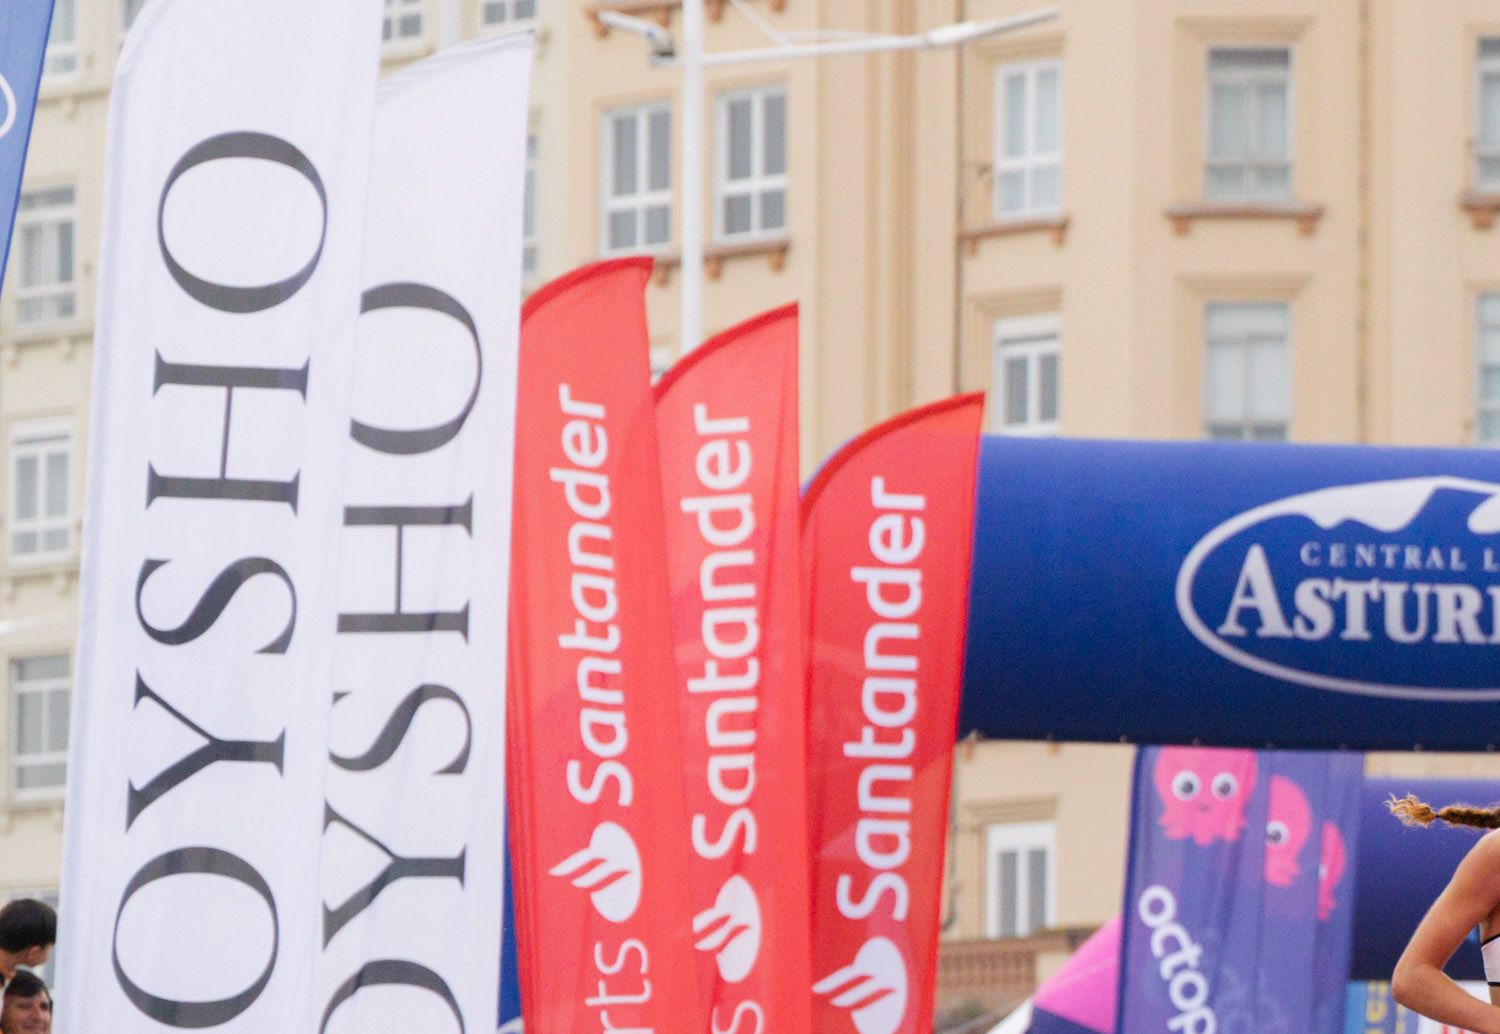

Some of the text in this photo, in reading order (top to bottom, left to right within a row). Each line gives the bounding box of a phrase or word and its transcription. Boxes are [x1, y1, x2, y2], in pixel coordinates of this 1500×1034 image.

[112, 130, 328, 1030] OYSHO
[549, 383, 634, 807] Santander
[680, 402, 760, 860] Santander
[836, 476, 926, 921] Santander
[1300, 541, 1466, 572] CENTRAL
